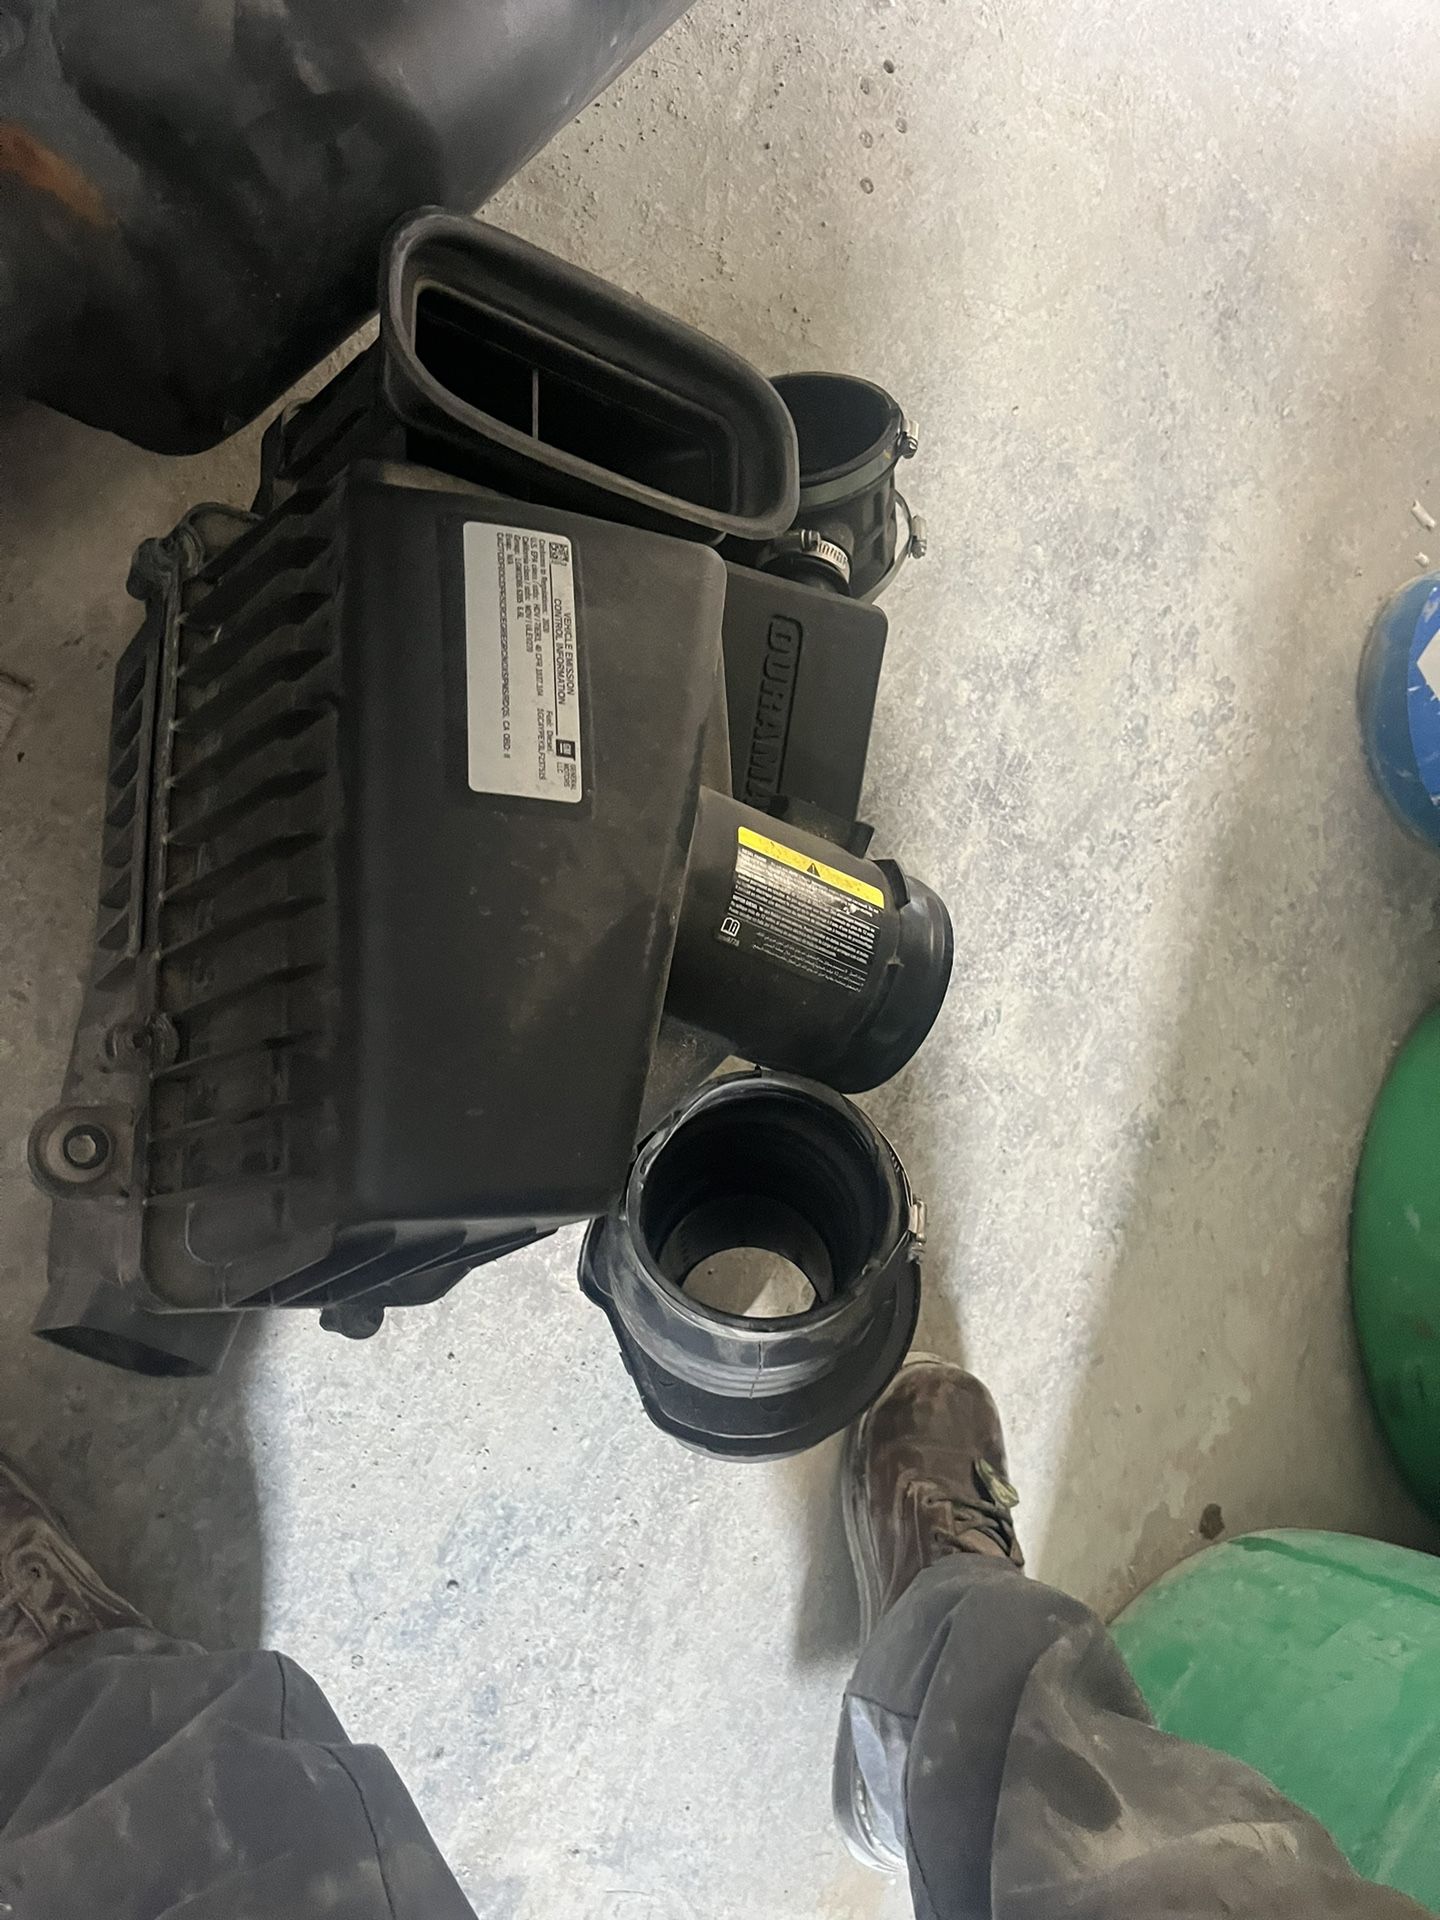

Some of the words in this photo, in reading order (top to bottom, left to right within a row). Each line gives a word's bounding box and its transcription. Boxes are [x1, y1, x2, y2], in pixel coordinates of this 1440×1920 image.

[554, 599, 563, 640] CONTROL
[564, 613, 572, 650] VEHICLE
[556, 643, 566, 704] INFORMATION
[565, 652, 575, 695] EMISSION
